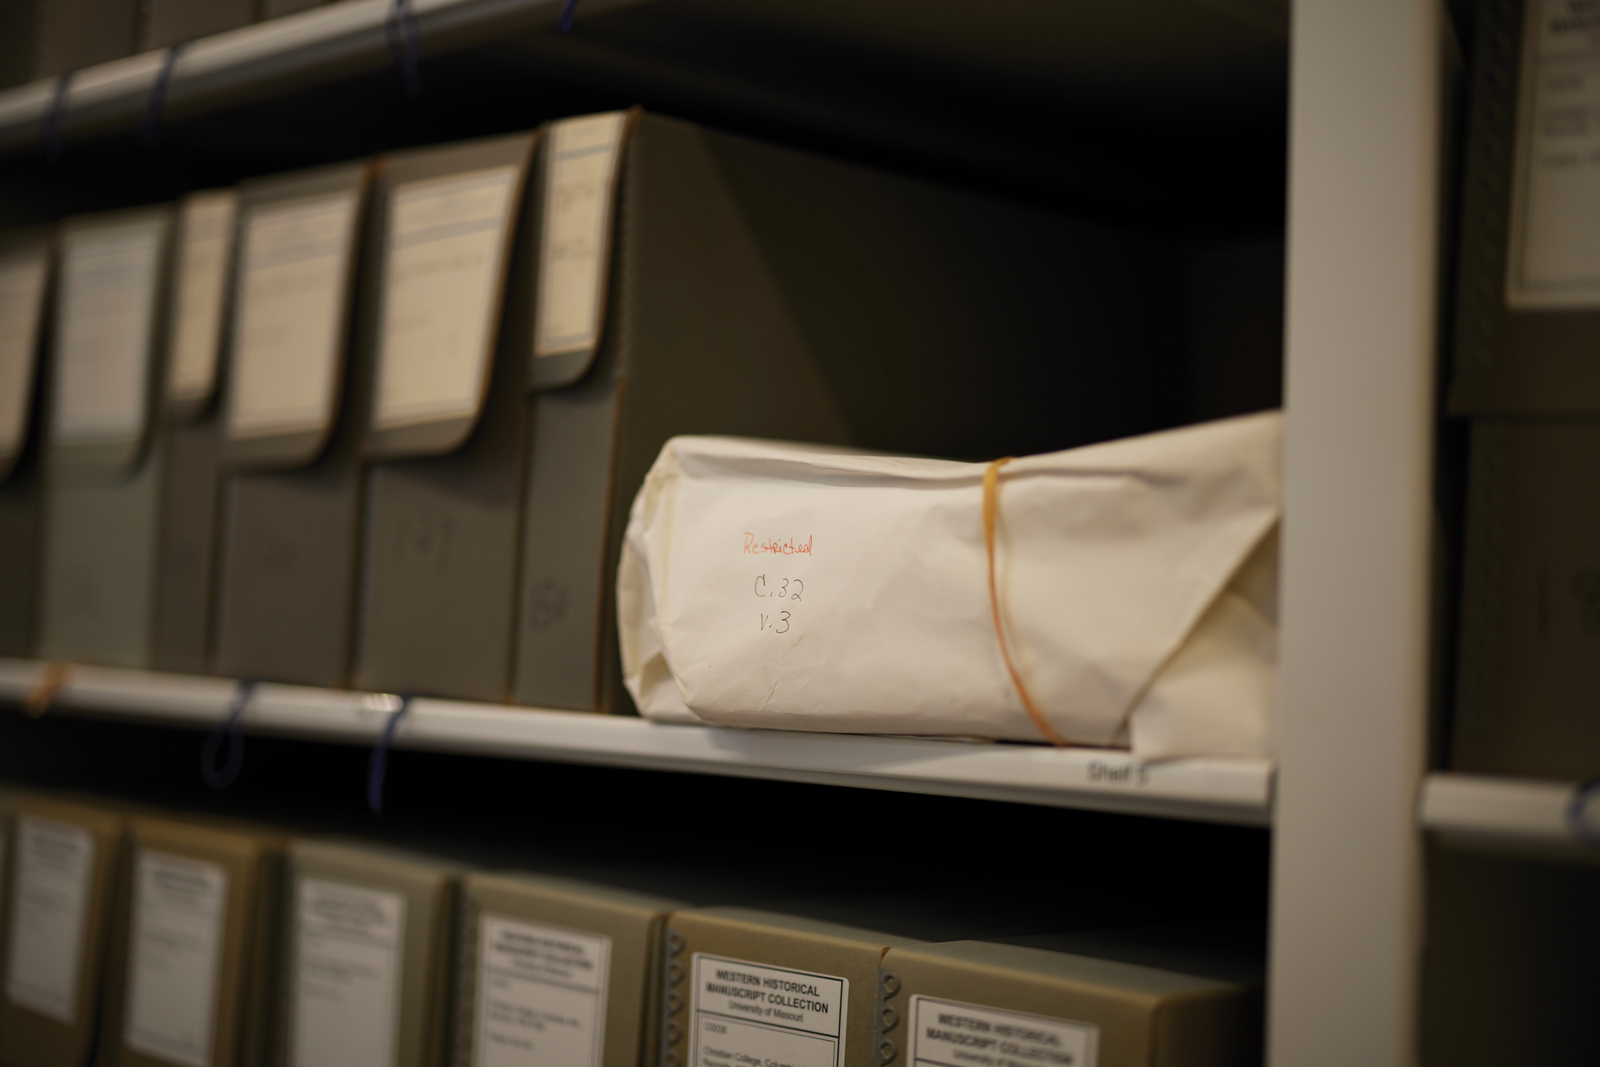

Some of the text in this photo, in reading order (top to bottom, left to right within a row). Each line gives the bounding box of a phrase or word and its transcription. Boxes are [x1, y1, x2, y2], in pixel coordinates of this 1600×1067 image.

[743, 531, 813, 556] Restricted
[754, 573, 804, 602] C.32
[716, 969, 820, 997] WESTERN HISTORICAL
[705, 981, 829, 1014] MANUSCRIPT COLLECTION
[729, 1000, 804, 1022] University of Missouri
[703, 1046, 732, 1060] Christian
